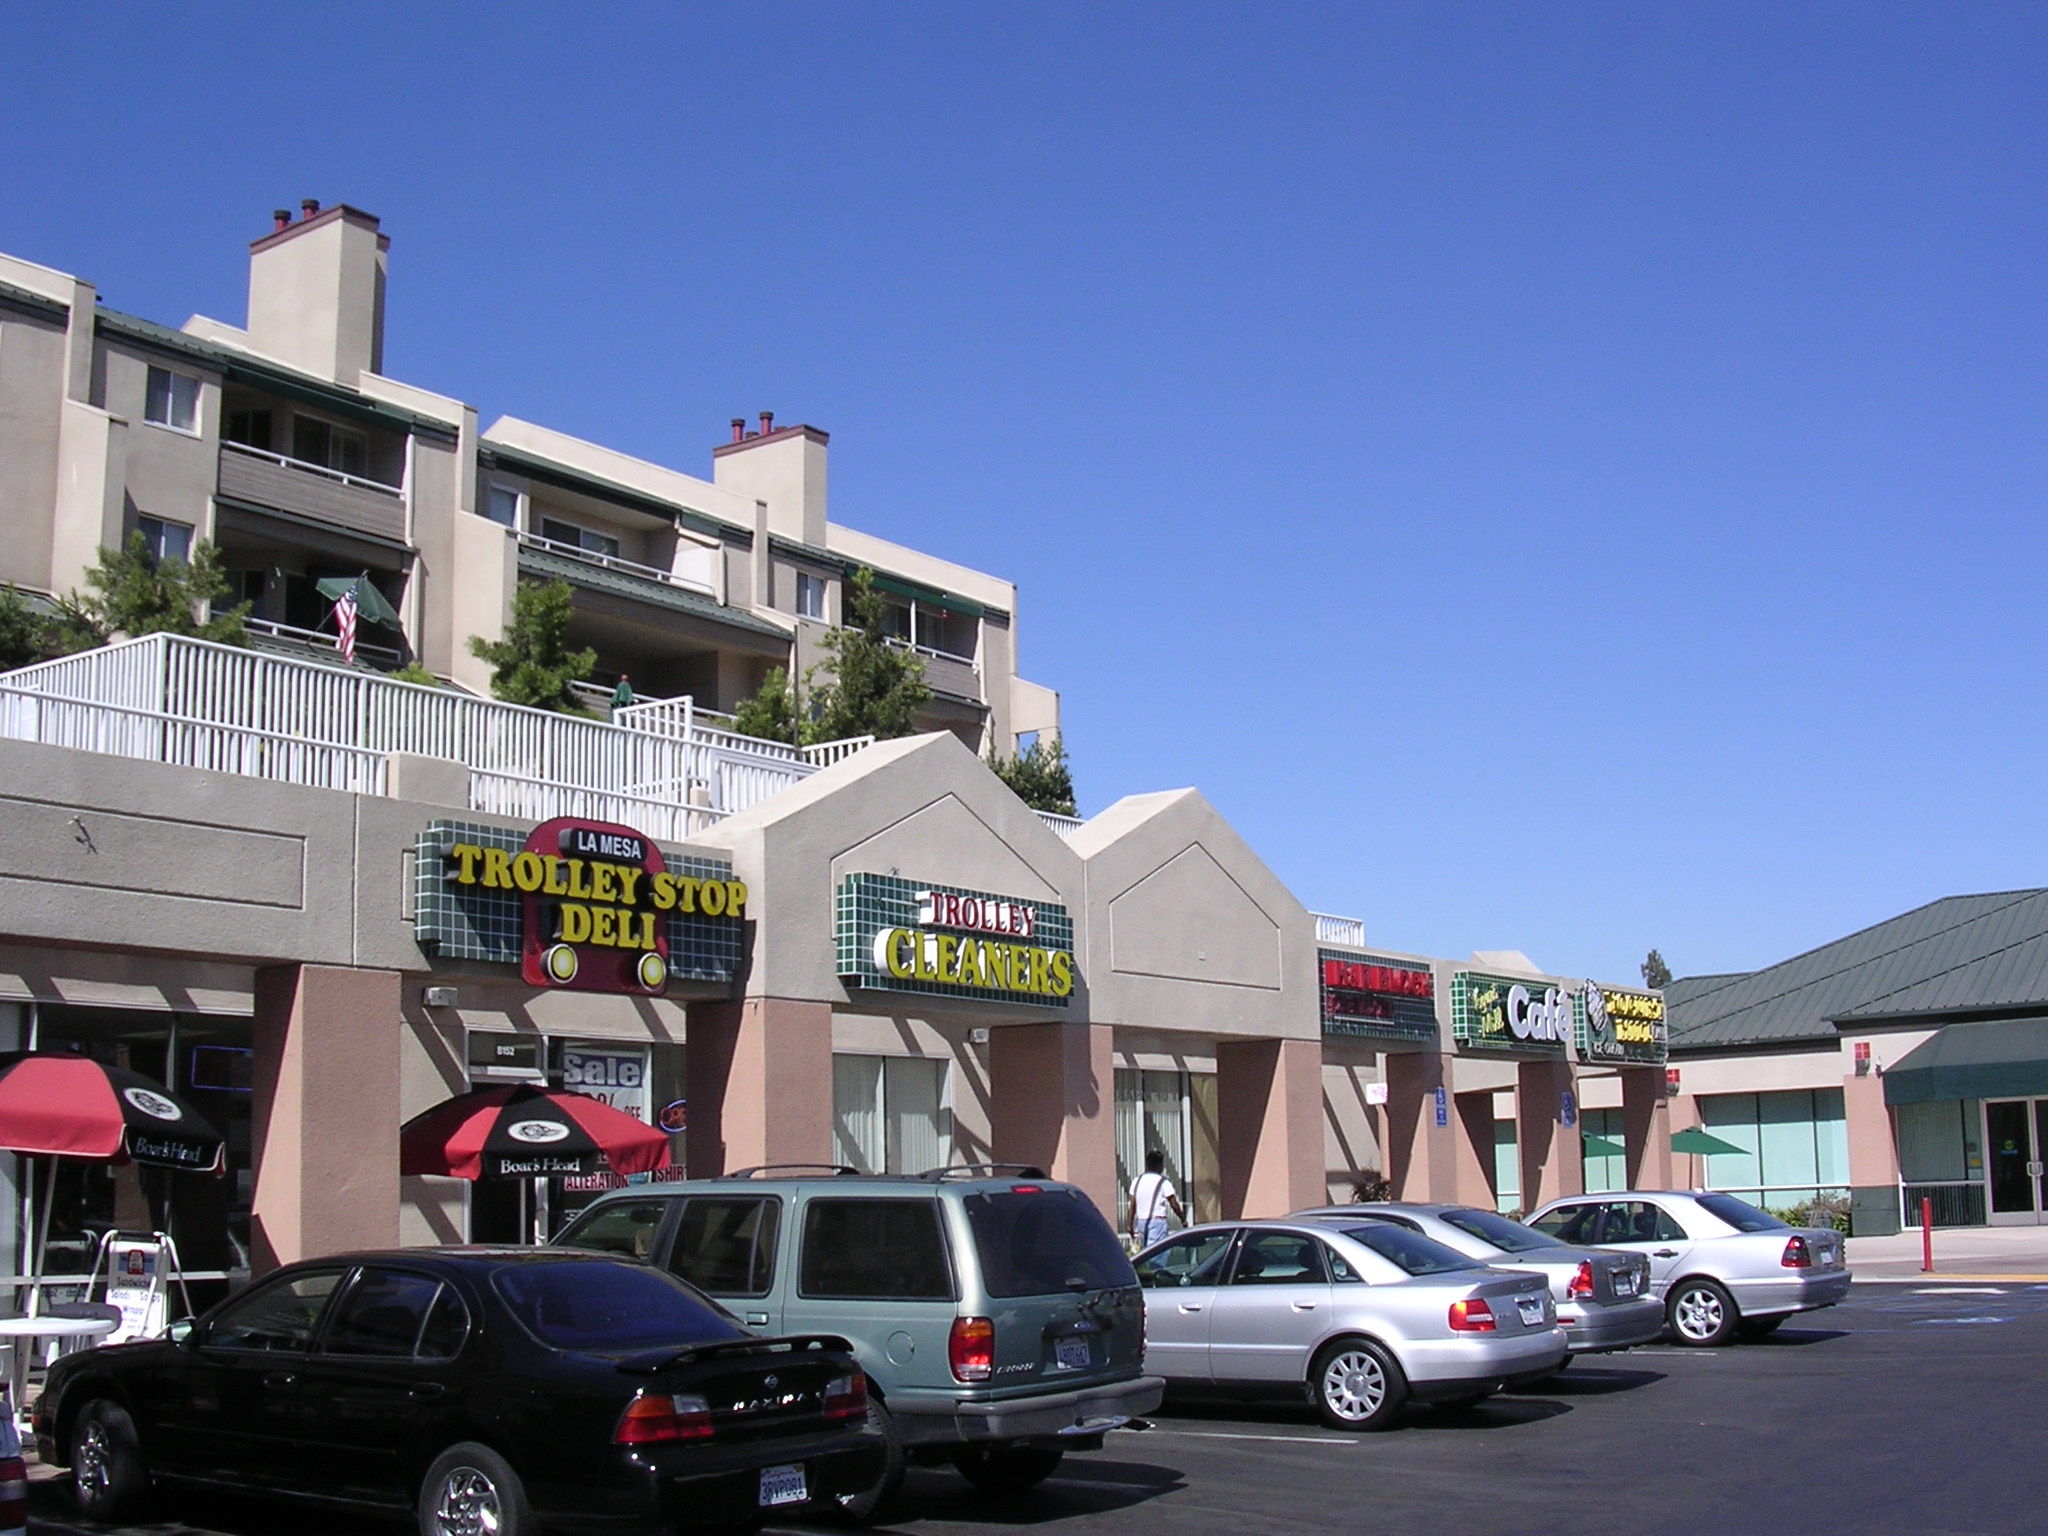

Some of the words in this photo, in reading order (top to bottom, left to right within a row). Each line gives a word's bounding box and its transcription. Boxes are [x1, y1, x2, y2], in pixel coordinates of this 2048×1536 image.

[578, 831, 597, 851] LA
[600, 833, 642, 859] MESA
[450, 843, 643, 905] TROLLEY
[653, 871, 748, 917] STOP
[560, 902, 657, 950] DELI
[928, 891, 1037, 938] TROLLEY
[885, 927, 1073, 996] CLEANERS
[1507, 984, 1573, 1041] Café
[564, 1052, 642, 1087] Sale
[501, 1157, 541, 1174] Boar's
[542, 1157, 581, 1172] Head
[656, 1166, 687, 1182] SHIR
